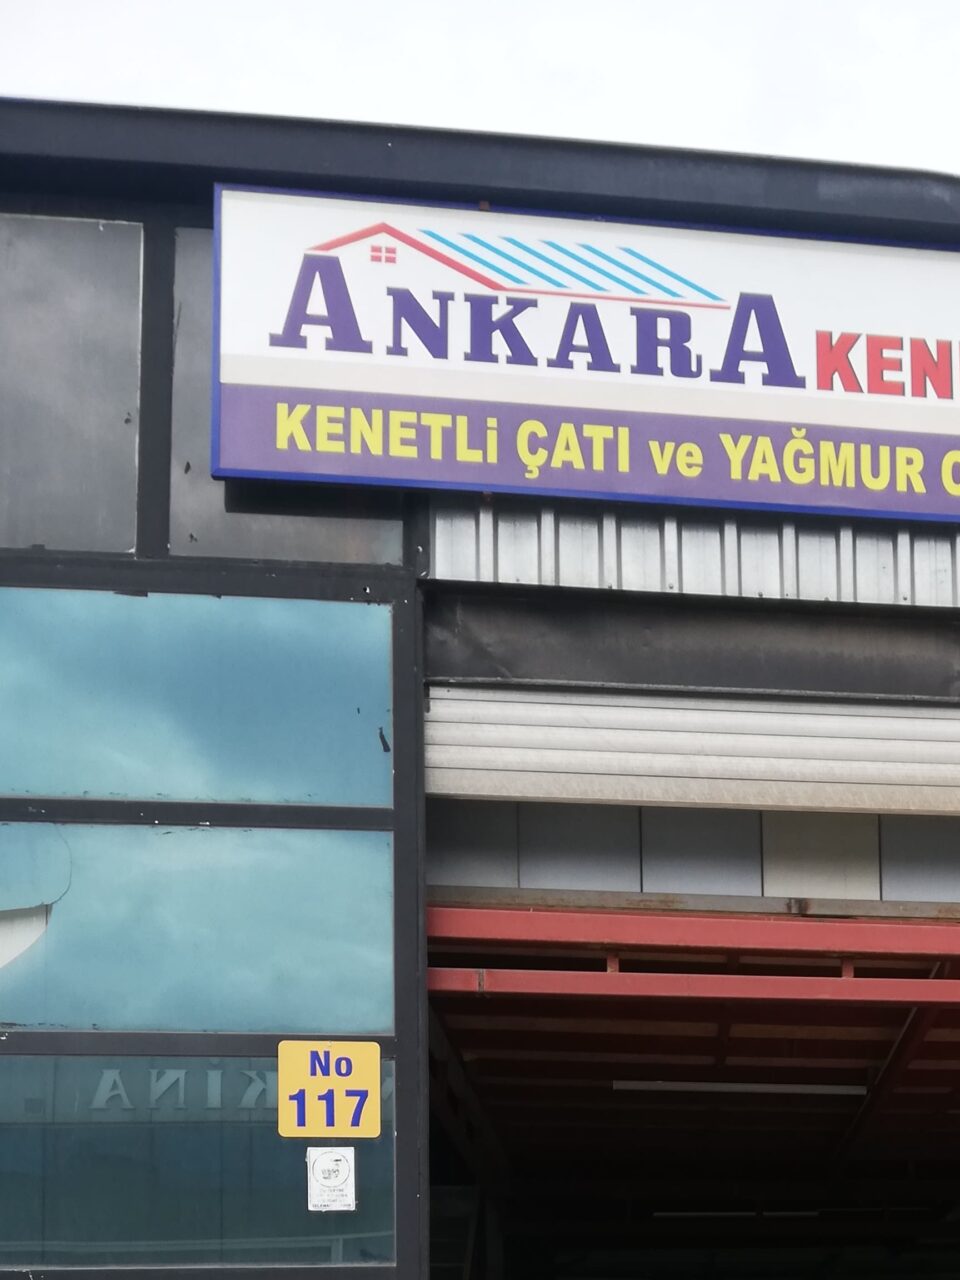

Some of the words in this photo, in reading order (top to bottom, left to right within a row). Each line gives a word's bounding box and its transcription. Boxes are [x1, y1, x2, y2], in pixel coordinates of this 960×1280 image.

[269, 253, 807, 390] ANKARA
[515, 419, 630, 479] ÇATI
[649, 440, 704, 478] ve
[720, 427, 926, 494] YAĞMUR
[289, 1089, 369, 1127] 117
